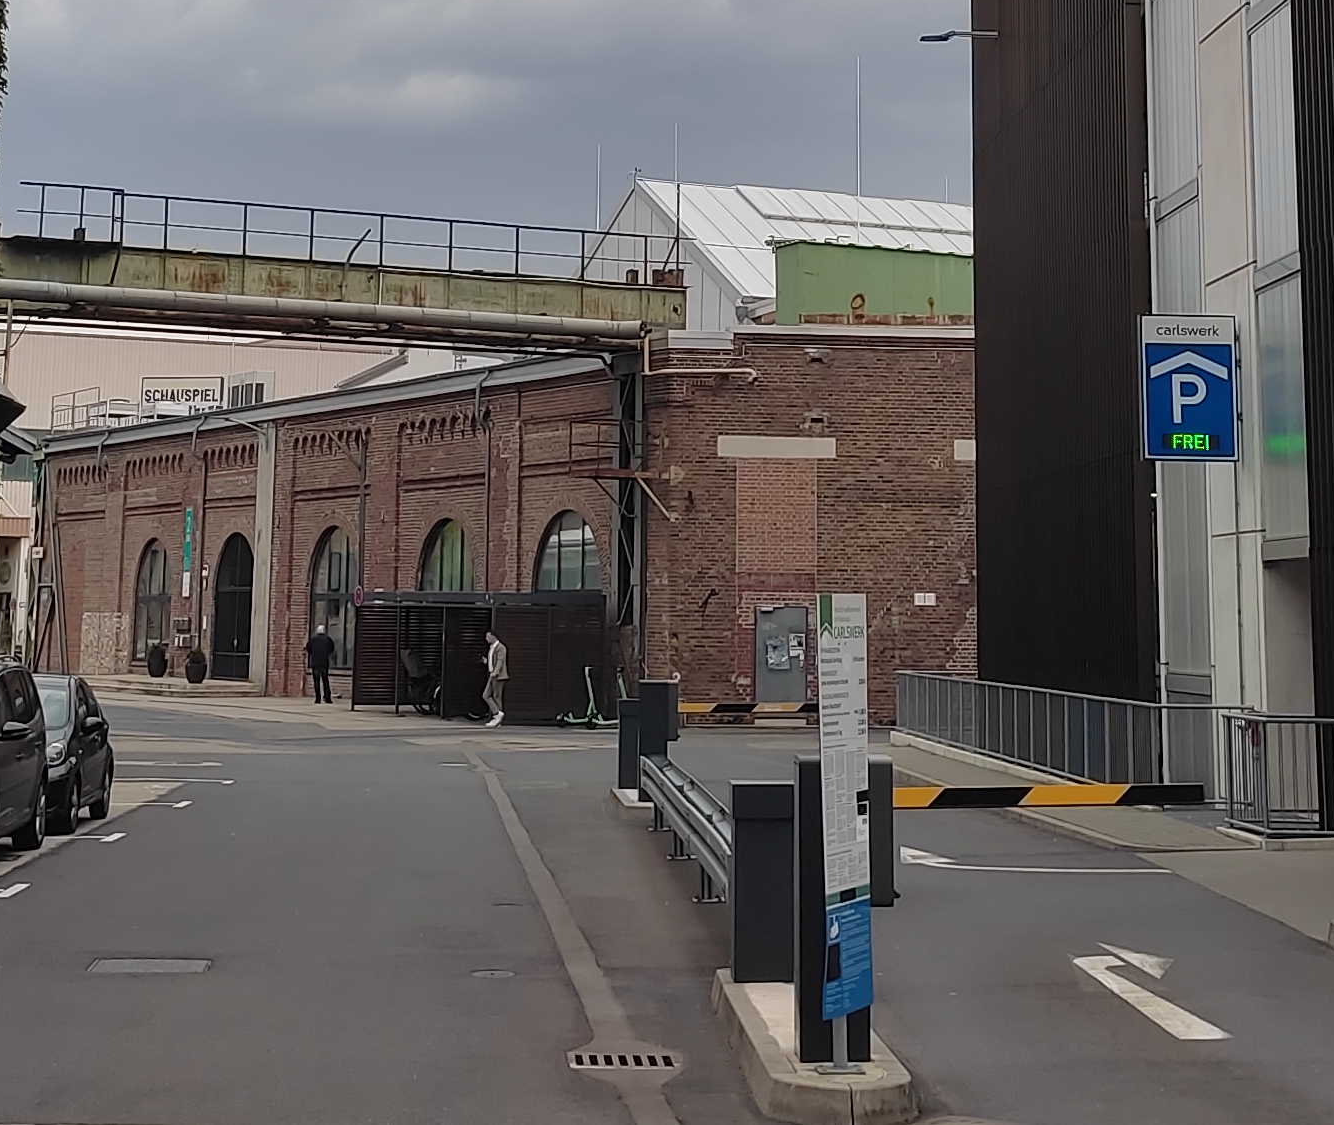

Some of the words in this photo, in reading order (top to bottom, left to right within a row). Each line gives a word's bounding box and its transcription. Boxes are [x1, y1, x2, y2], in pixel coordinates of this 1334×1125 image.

[1156, 324, 1219, 337] carlswerk
[144, 388, 218, 403] SCHAUSPIEL
[1172, 374, 1207, 424] P
[1172, 433, 1209, 451] FREI
[834, 625, 865, 639] CARLSWERK
